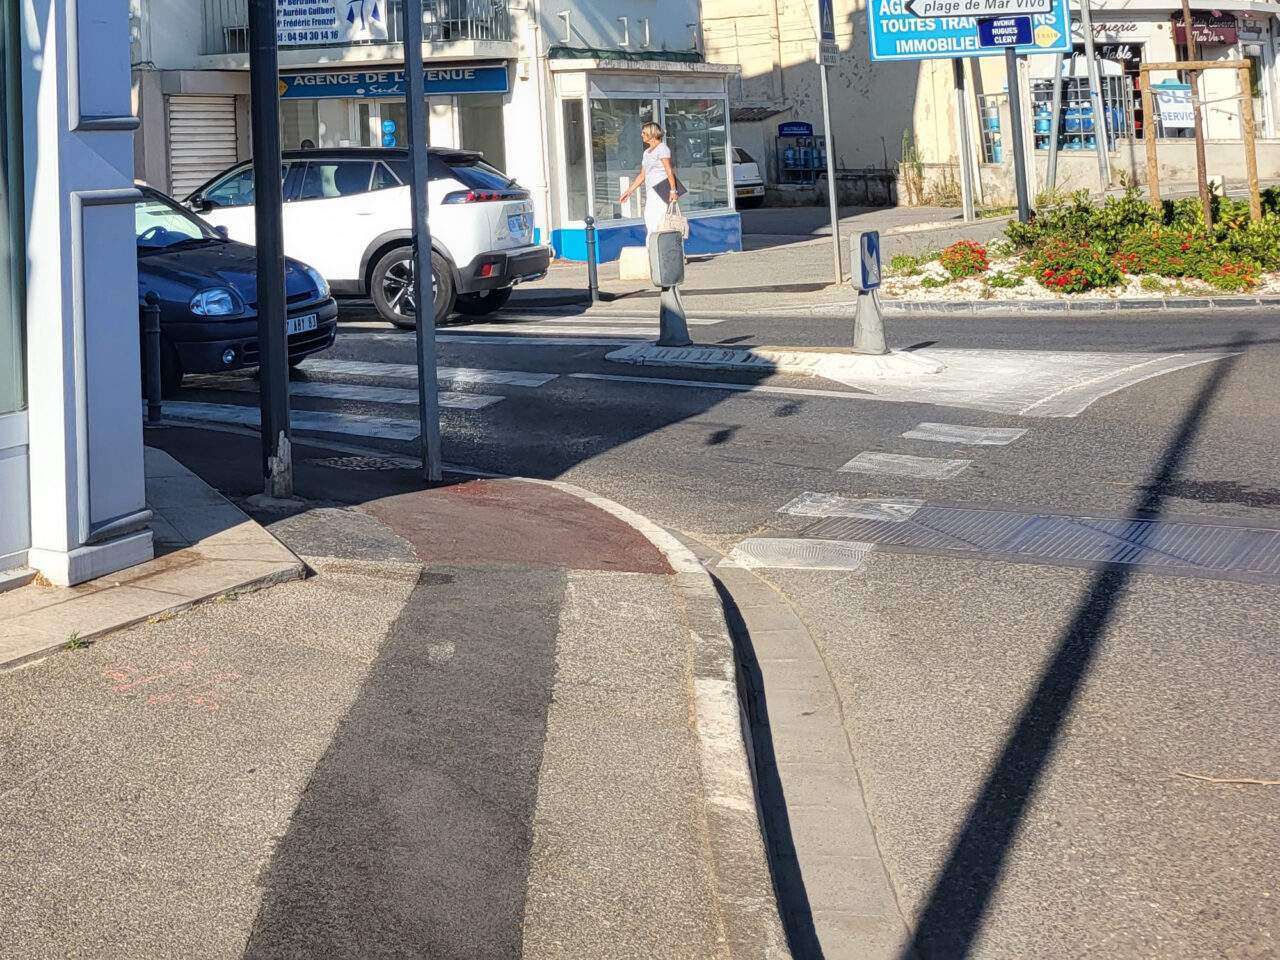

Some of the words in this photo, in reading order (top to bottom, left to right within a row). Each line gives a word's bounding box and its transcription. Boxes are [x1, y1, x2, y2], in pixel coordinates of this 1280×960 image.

[924, 0, 960, 14] plage
[880, 17, 936, 33] TOUTES
[287, 32, 297, 41] 04
[298, 31, 308, 41] 94
[309, 31, 319, 40] 30
[320, 30, 329, 40] 14
[991, 27, 1018, 35] HUGUES
[994, 36, 1017, 44] CLERY
[293, 73, 360, 86] AGENCE
[365, 72, 389, 83] DE
[394, 68, 476, 83] L'ENUE
[1161, 111, 1195, 121] SERVIC
